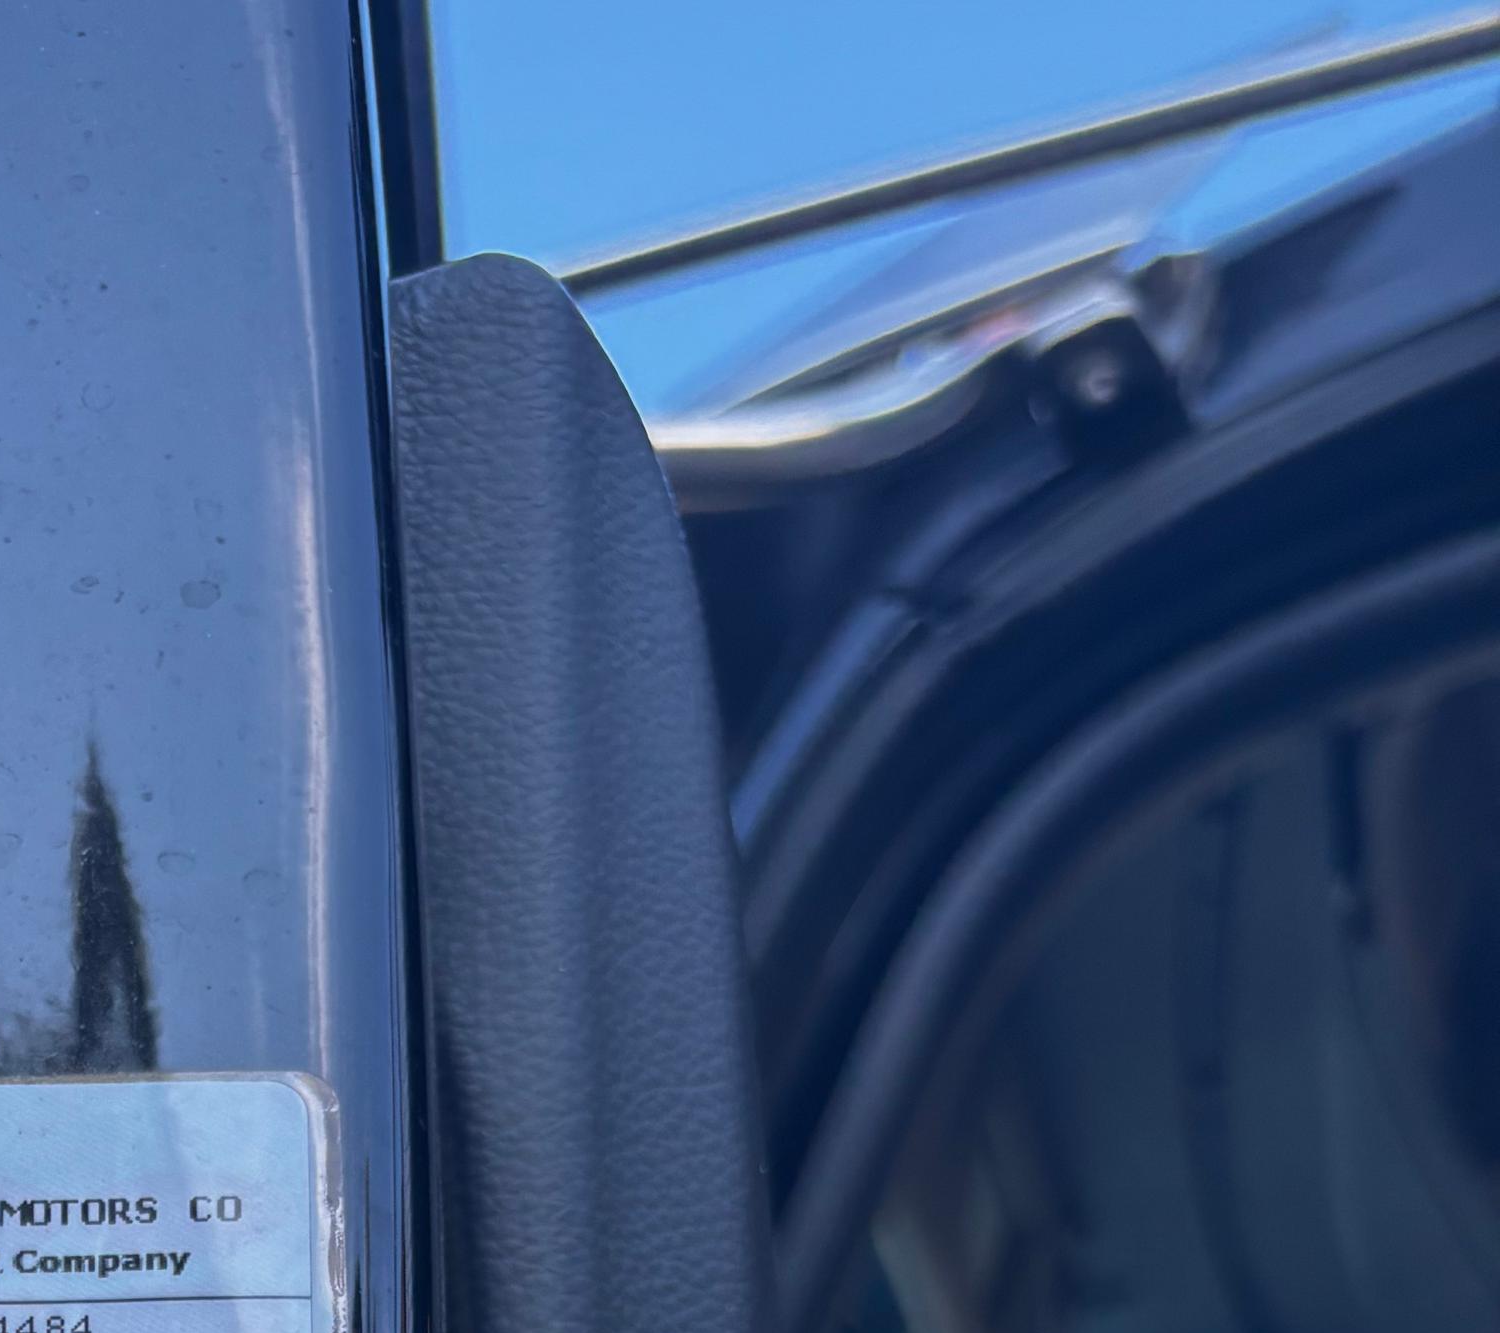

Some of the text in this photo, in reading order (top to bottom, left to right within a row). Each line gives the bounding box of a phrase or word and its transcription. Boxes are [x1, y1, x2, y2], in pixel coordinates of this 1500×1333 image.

[0, 1197, 157, 1227] MOTORS
[190, 1196, 241, 1222] CO
[13, 1250, 191, 1278] Company
